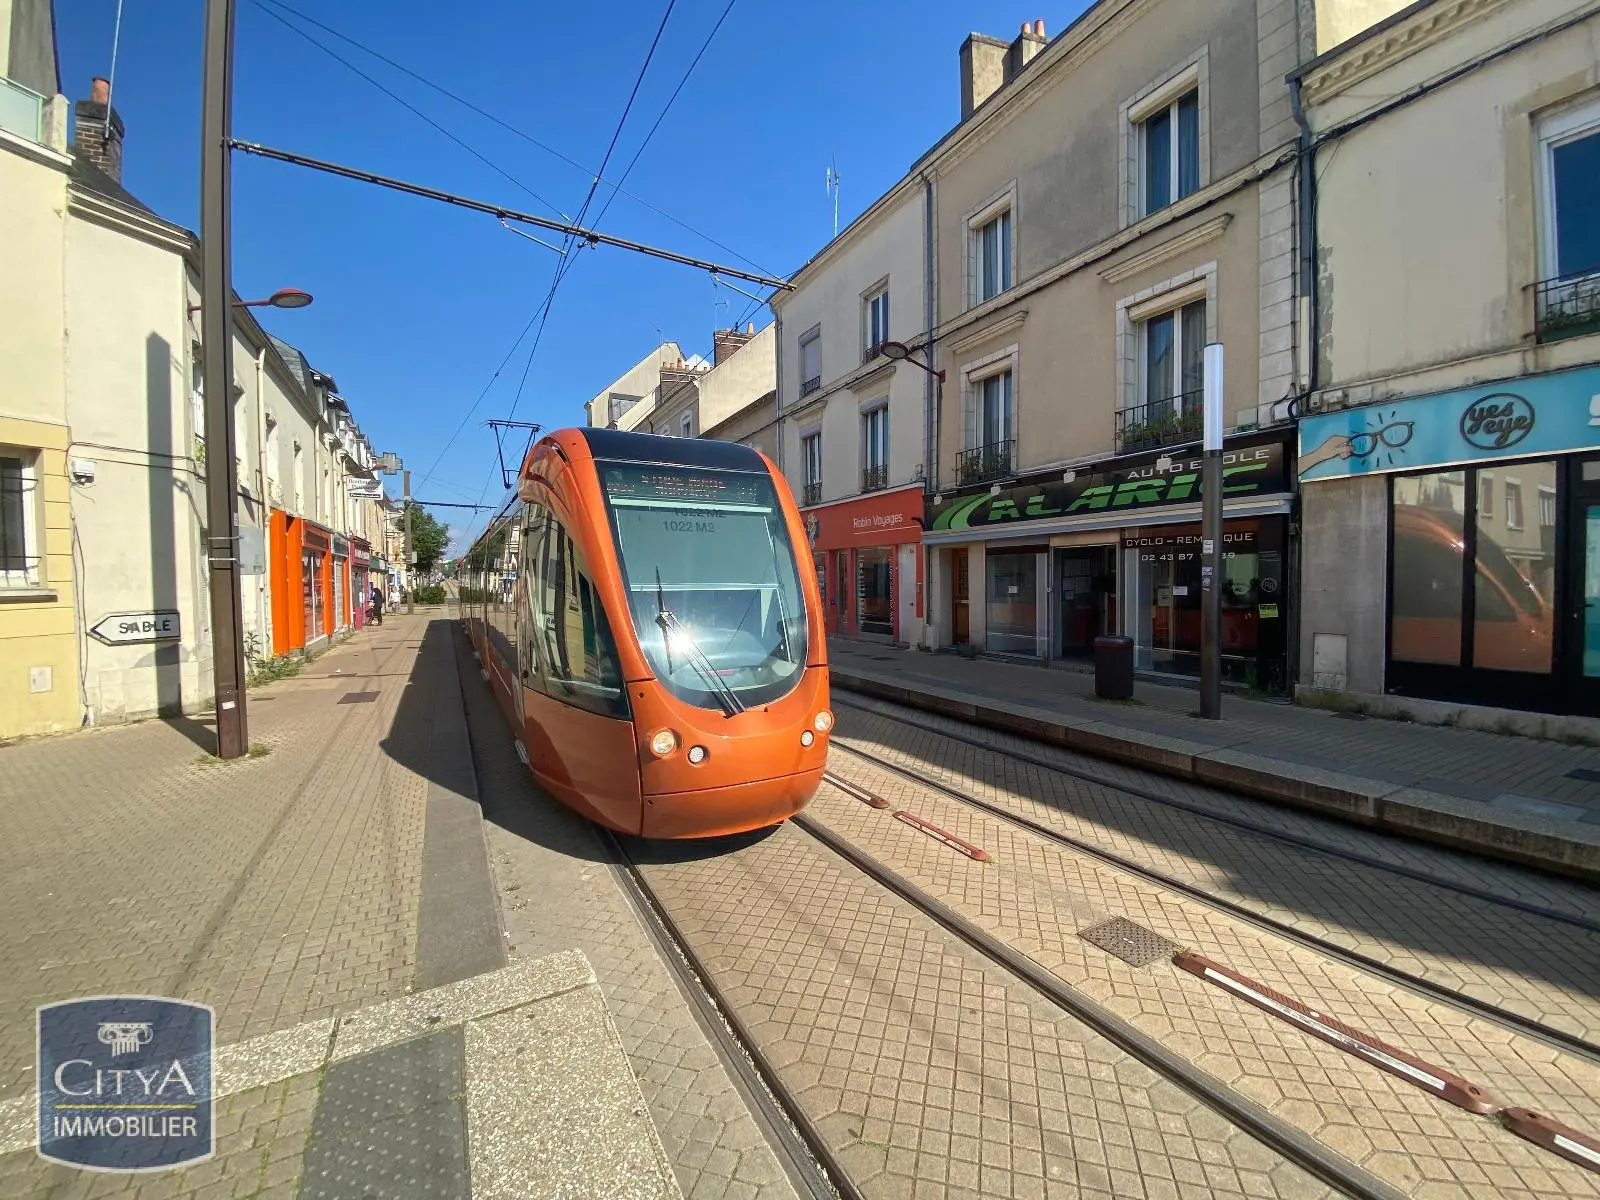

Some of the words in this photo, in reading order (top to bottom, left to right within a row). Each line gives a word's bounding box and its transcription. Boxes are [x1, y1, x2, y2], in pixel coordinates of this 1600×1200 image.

[1467, 402, 1514, 434] yes
[1483, 415, 1531, 448] eye
[1190, 449, 1270, 470] EOLE
[663, 521, 693, 532] 1022
[853, 516, 871, 528] Robin
[872, 513, 903, 527] Voyages
[1141, 553, 1156, 561] 02
[1159, 553, 1174, 561] 43
